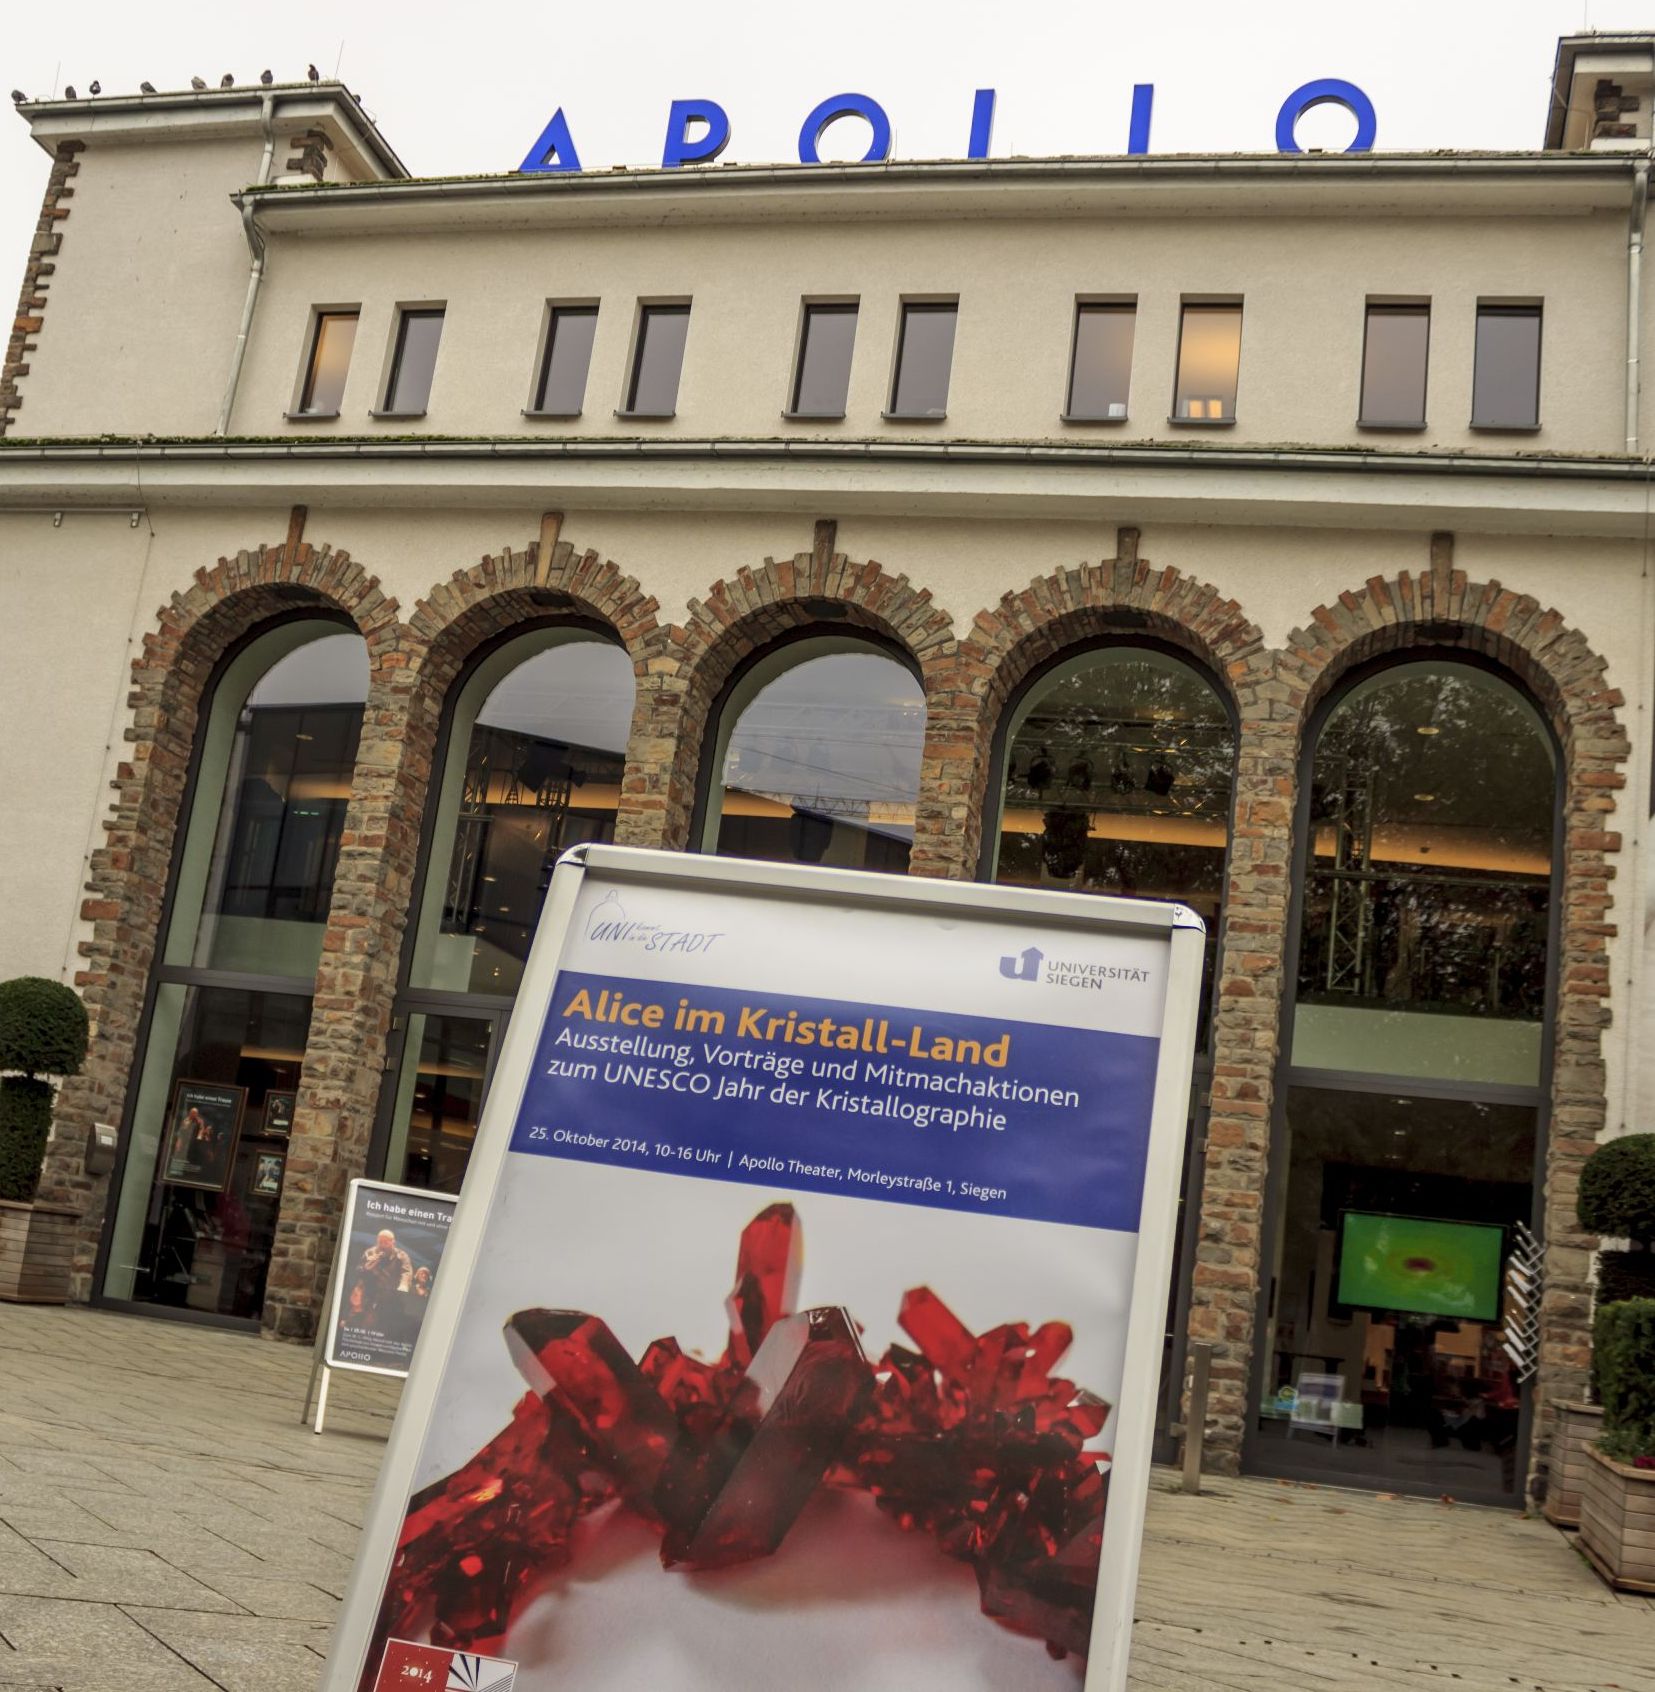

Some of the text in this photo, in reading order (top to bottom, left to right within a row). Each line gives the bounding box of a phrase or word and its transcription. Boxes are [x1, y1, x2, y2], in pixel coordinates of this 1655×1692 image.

[645, 932, 726, 953] STADT
[1046, 973, 1103, 990] SIEGEN
[1048, 961, 1150, 983] UNIVERSITÄT
[563, 989, 1011, 1068] Alice im Kristall-Land
[555, 1027, 1080, 1108] Ausstellung, Vorträge und Mitmachaktionen
[547, 1059, 1007, 1132] zum UNESCO Jahr der Kristallographie
[529, 1126, 549, 1141] 25.
[553, 1129, 610, 1148] Oktober
[612, 1138, 650, 1156] 2014,
[654, 1144, 693, 1160] 10-16
[696, 1149, 721, 1164] Uhr
[738, 1154, 785, 1171] Apollo
[787, 1160, 843, 1181] Theater,
[847, 1168, 942, 1192] Morleystraße
[945, 1180, 956, 1195] 1,
[960, 1182, 1007, 1201] Siegen
[366, 1200, 382, 1210] Ich
[383, 1203, 407, 1215] habe
[408, 1208, 435, 1220] einen
[437, 1212, 453, 1223] Tra
[402, 1666, 433, 1682] 2014
